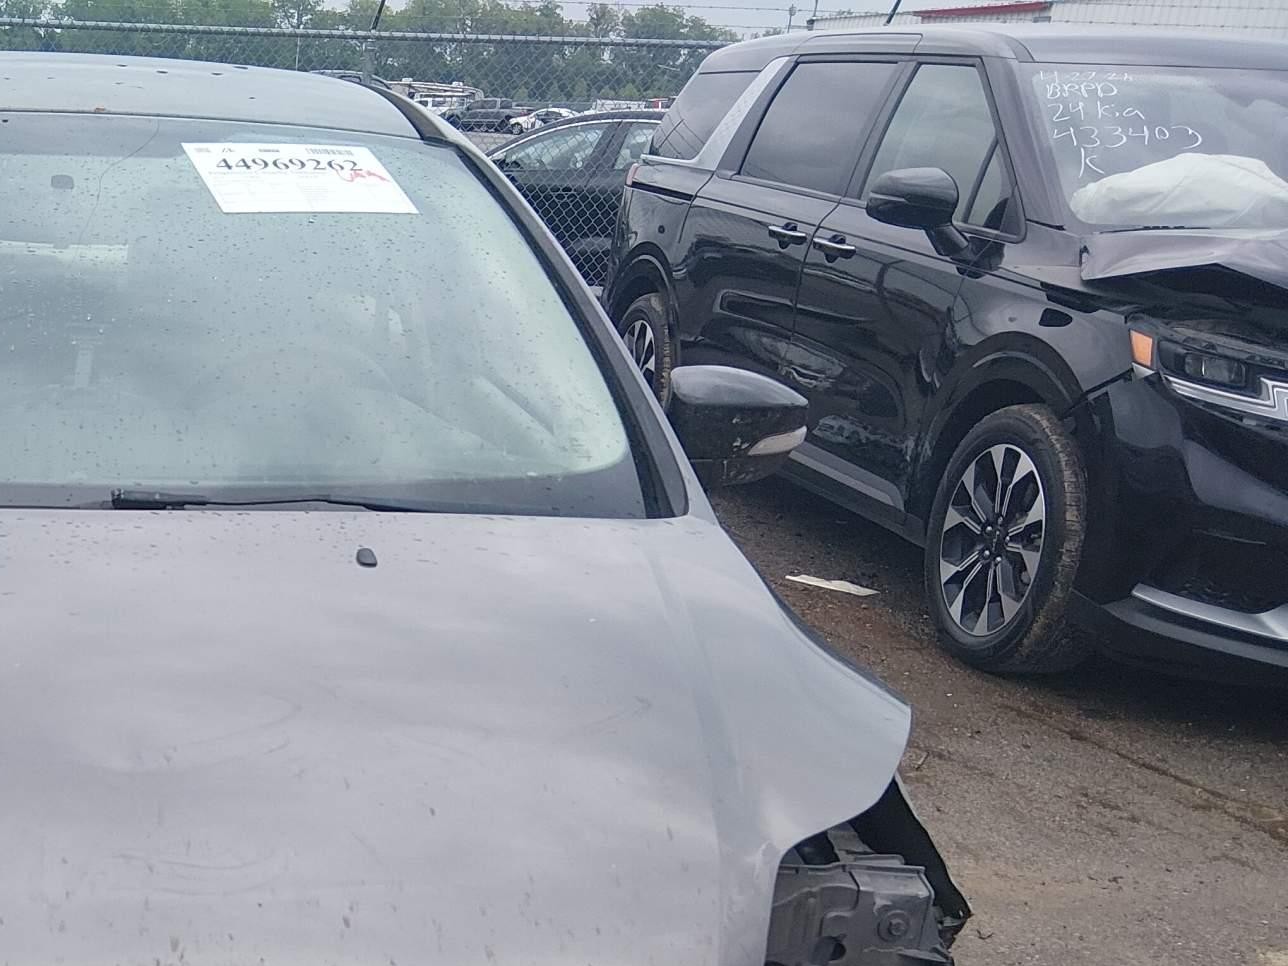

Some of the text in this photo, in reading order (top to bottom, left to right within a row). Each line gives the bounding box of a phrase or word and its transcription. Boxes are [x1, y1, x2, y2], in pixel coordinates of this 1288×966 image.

[1047, 102, 1084, 122] 24
[1053, 125, 1202, 149] 433403
[216, 157, 363, 171] 44969262
[1079, 147, 1105, 178] K
